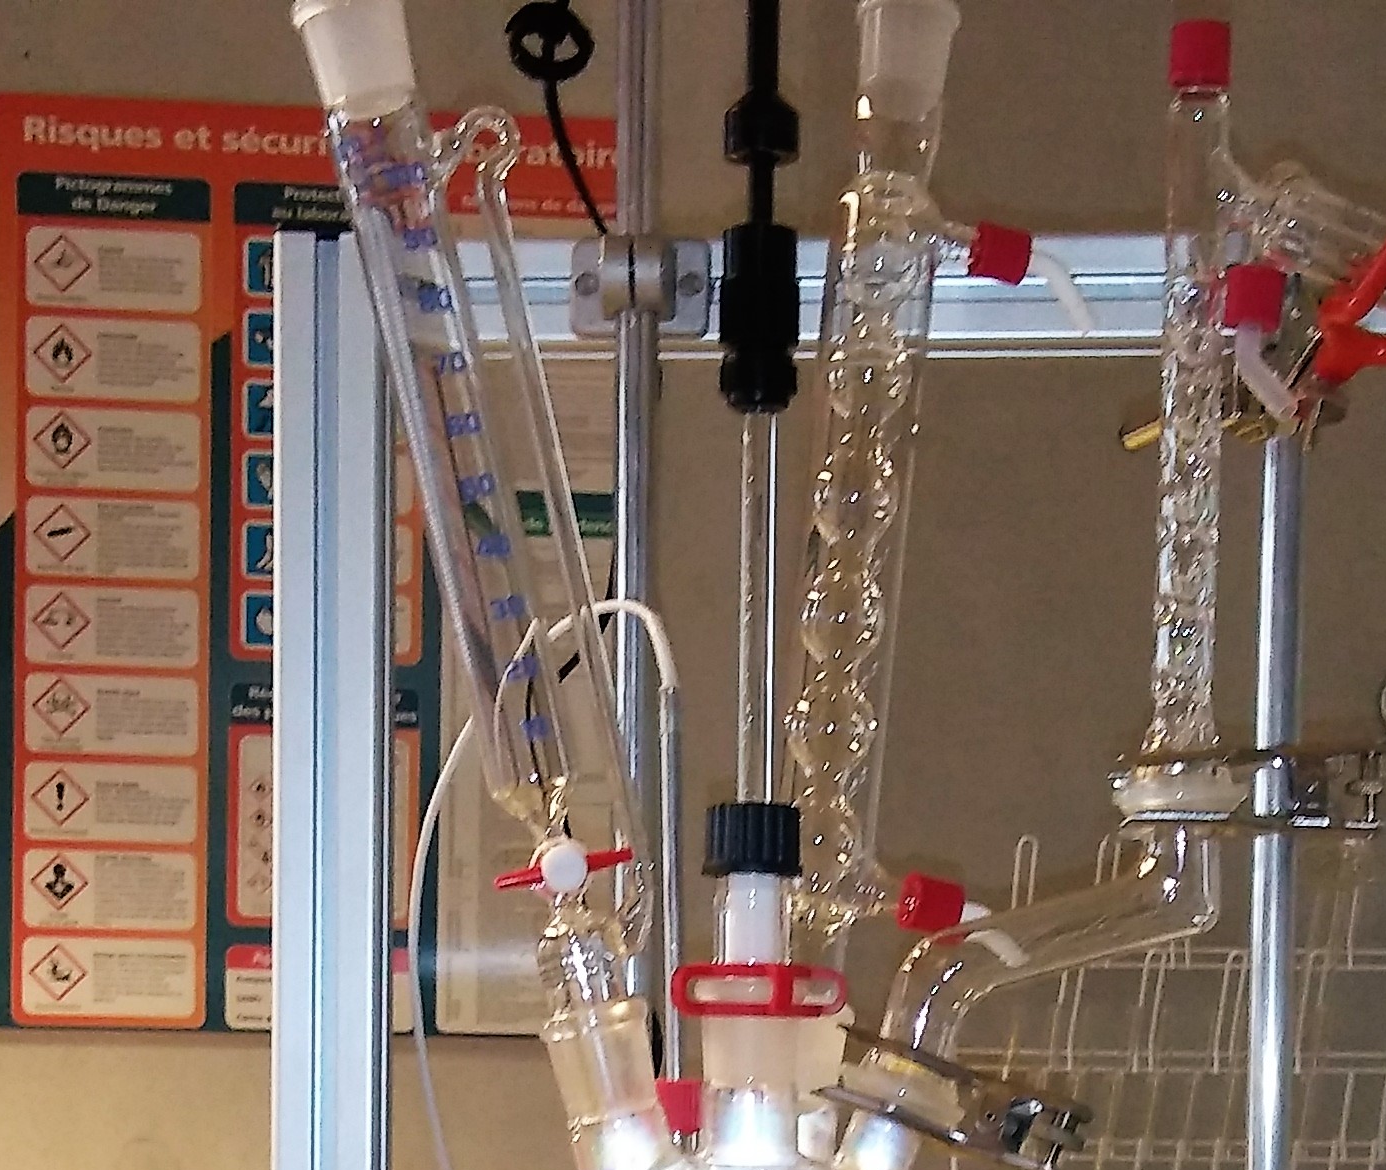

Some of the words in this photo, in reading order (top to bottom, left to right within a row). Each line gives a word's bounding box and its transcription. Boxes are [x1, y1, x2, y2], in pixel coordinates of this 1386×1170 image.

[23, 115, 162, 152] Risques
[174, 126, 211, 150] et
[437, 352, 467, 374] 70
